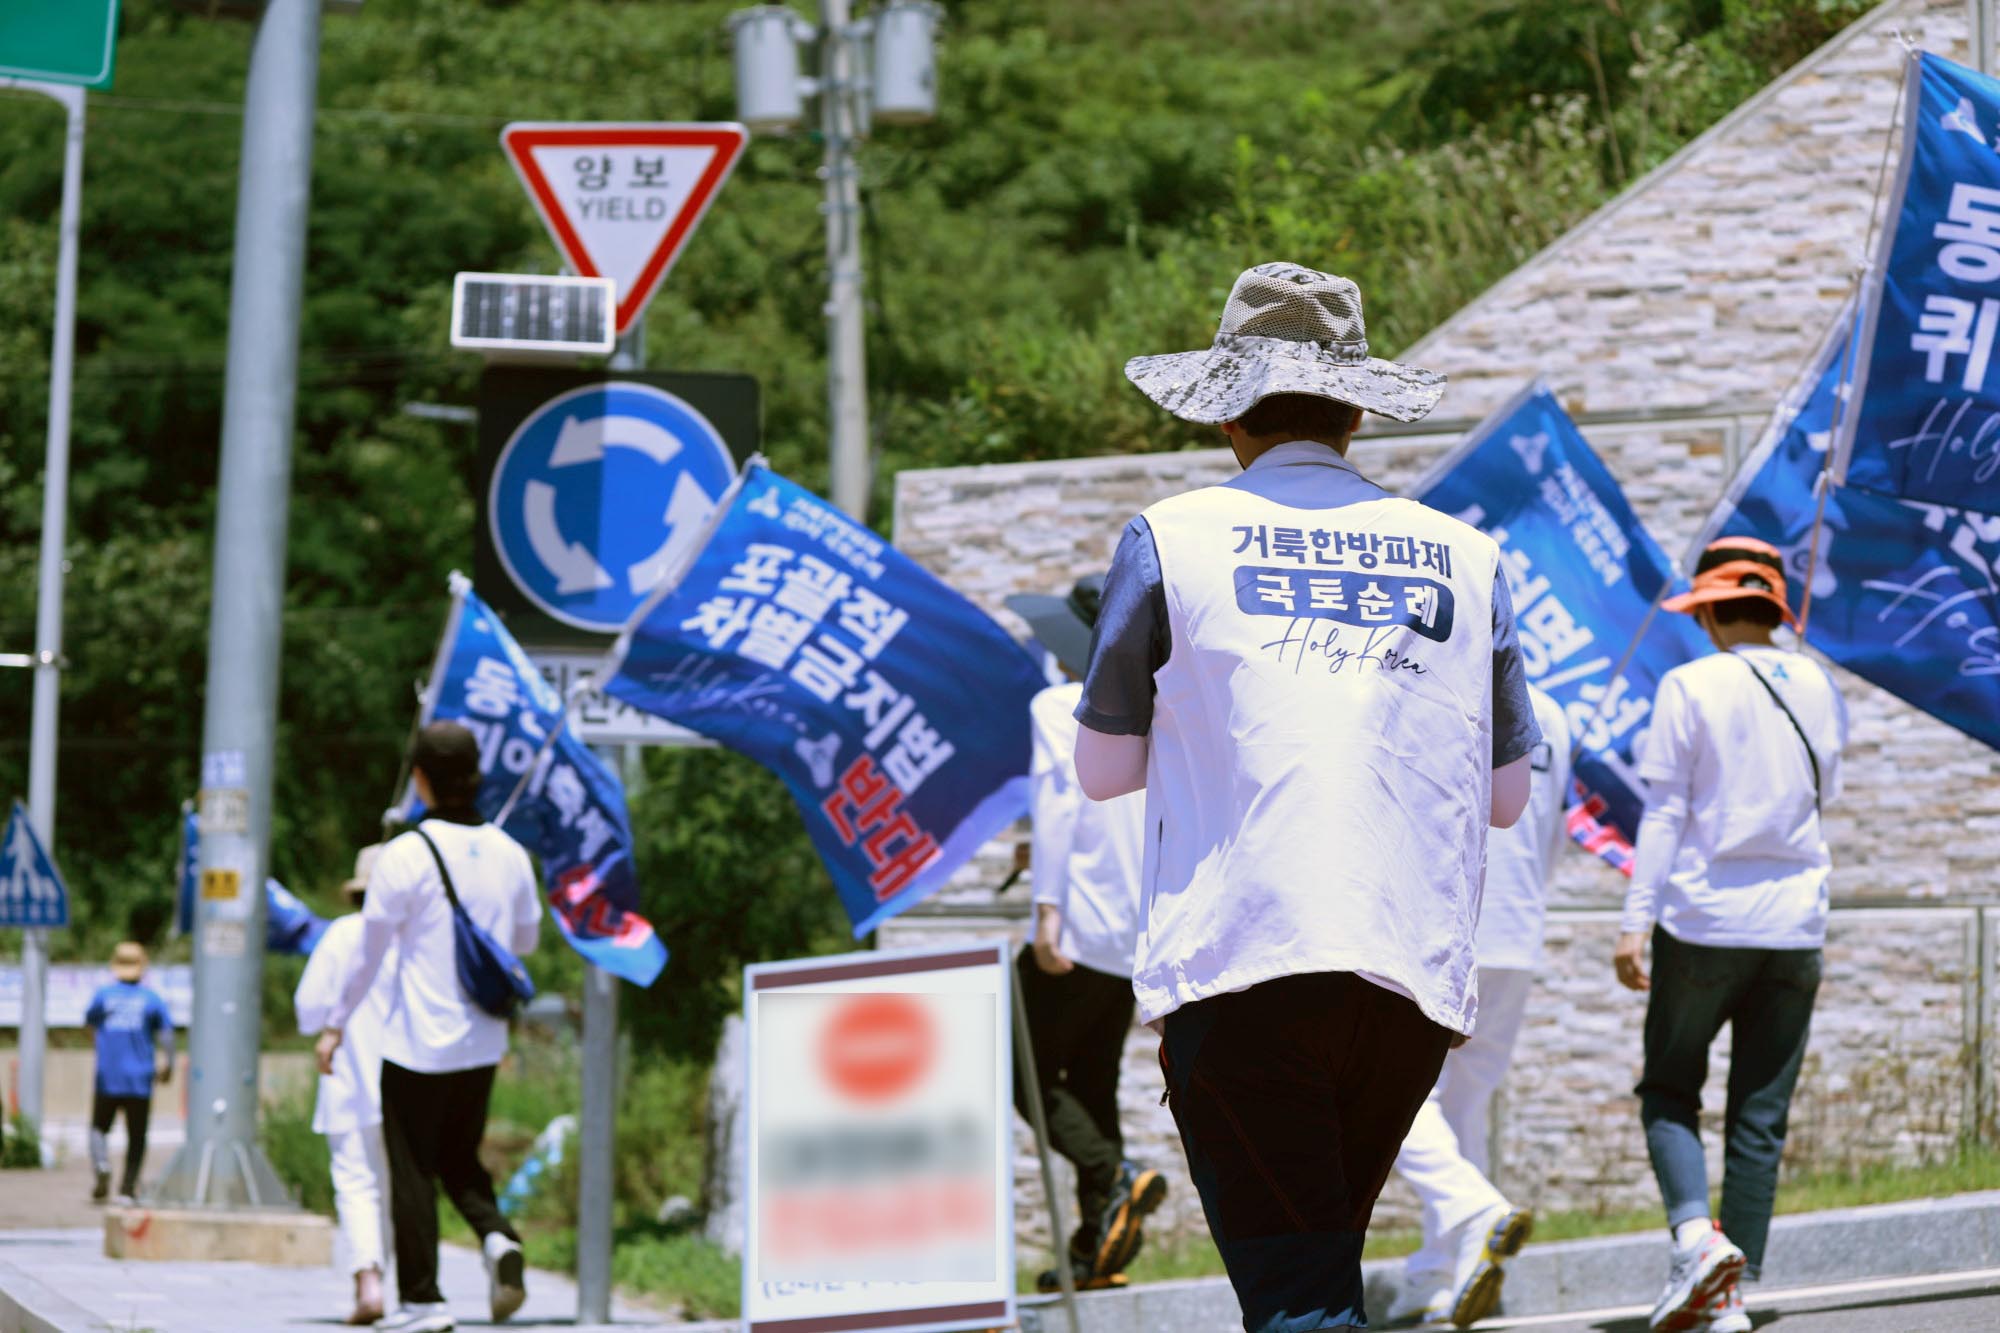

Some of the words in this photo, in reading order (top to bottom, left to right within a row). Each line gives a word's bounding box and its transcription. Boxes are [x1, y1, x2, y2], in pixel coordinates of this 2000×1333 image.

[576, 197, 666, 221] YIELD
[1232, 525, 1452, 579] 거룩한방파제
[719, 543, 908, 662] 포괄적
[1256, 573, 1439, 628] 국토순례
[1260, 616, 1355, 674] Holy
[681, 596, 956, 798] 차별금지법
[821, 752, 943, 903] 반대
